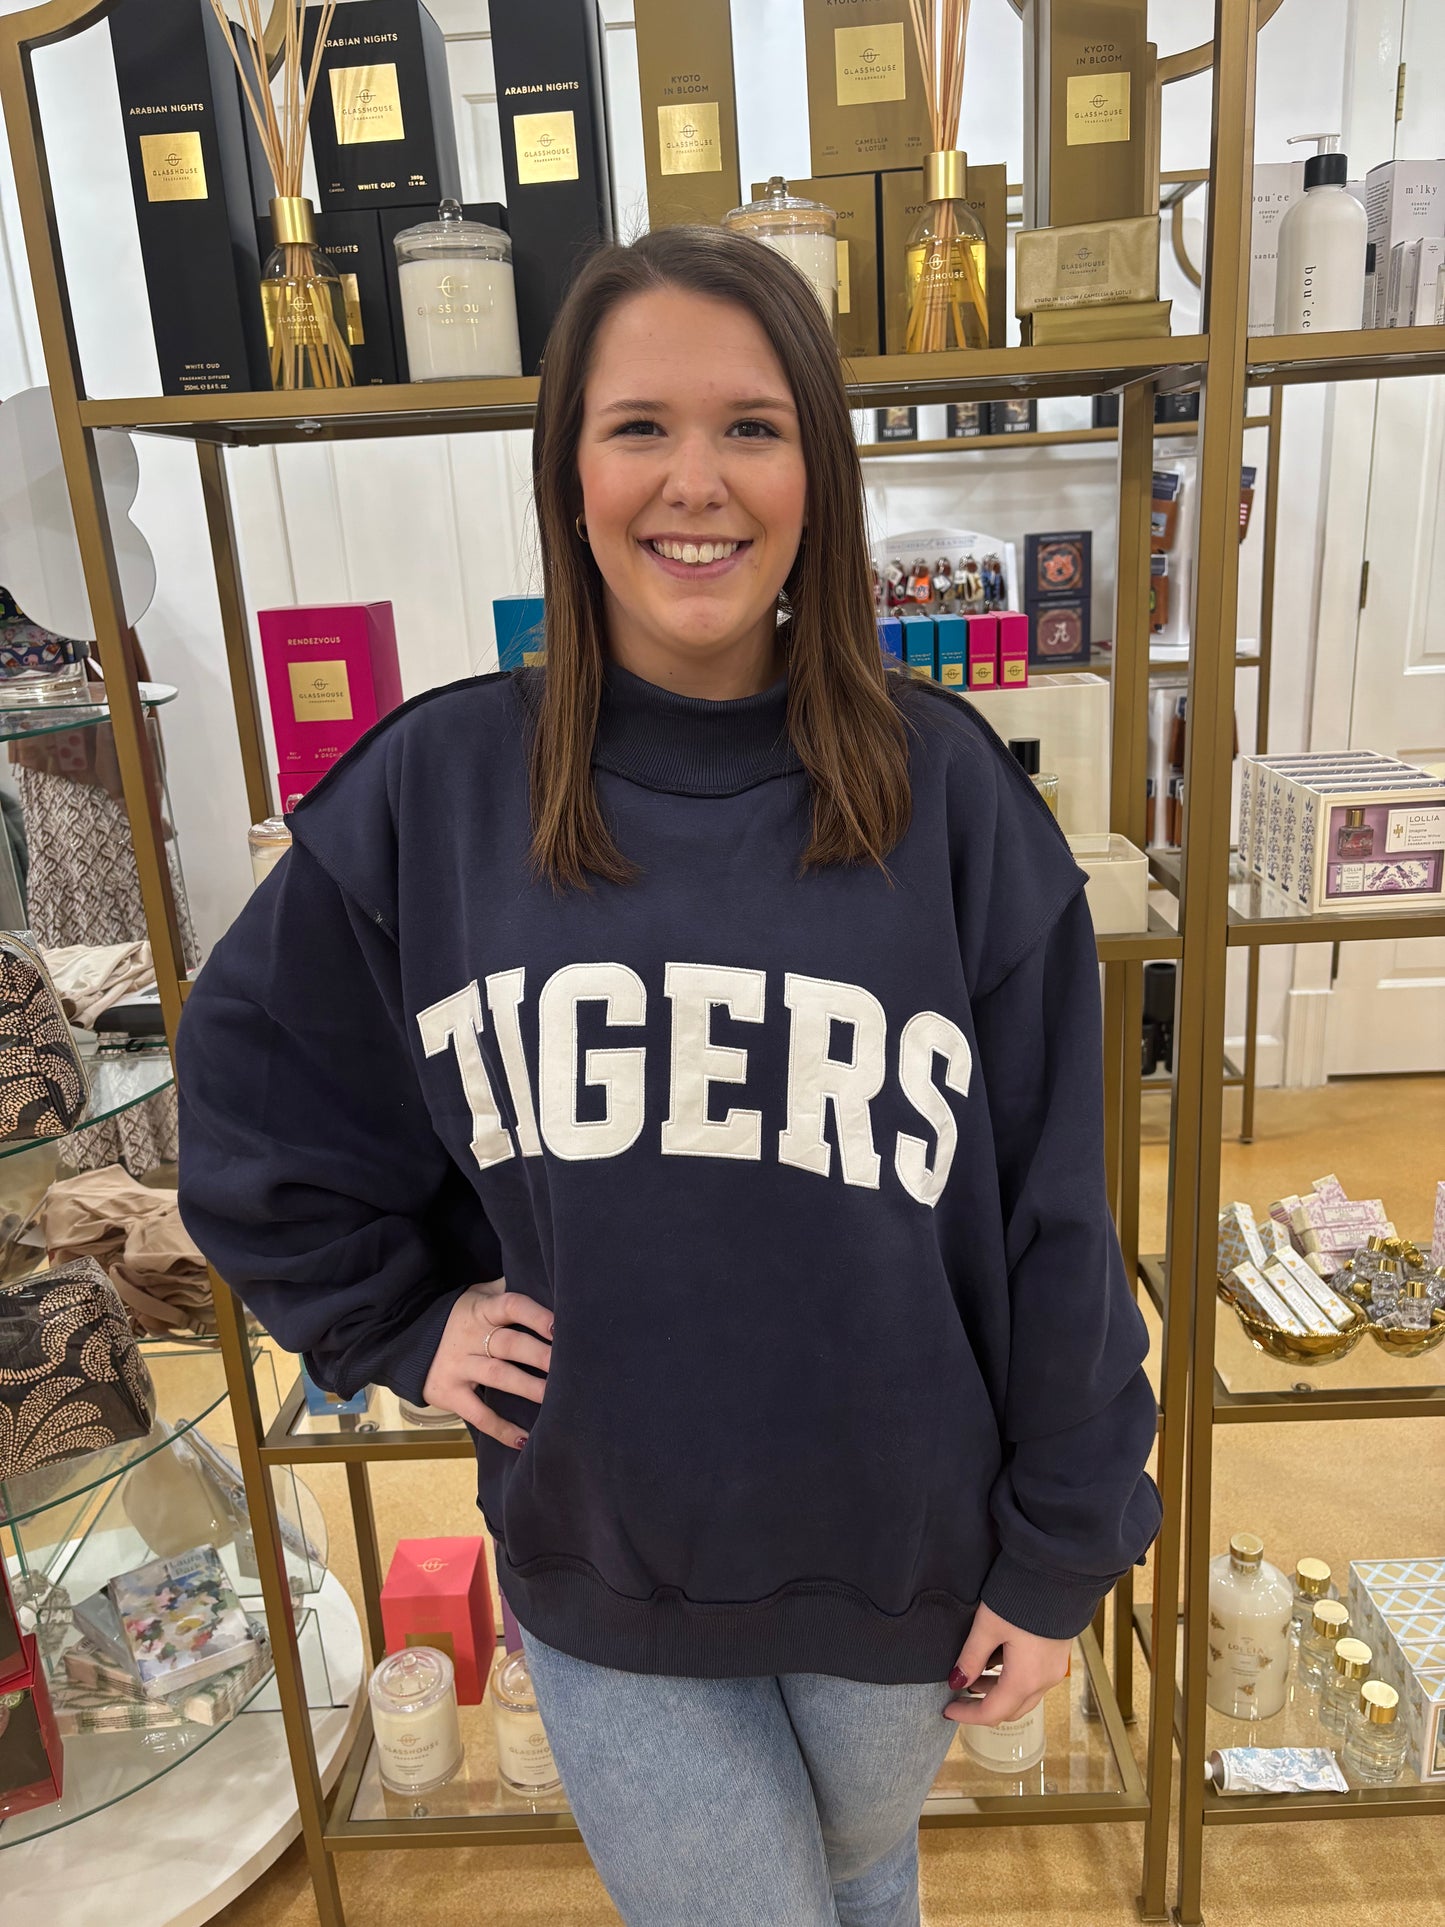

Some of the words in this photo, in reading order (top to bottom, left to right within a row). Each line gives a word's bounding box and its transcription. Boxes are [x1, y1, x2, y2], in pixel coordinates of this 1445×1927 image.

[363, 33, 398, 44] NIGHTS
[1084, 44, 1115, 54] KYOTO
[1089, 55, 1123, 64] BLOOM
[843, 64, 896, 75] GLASSHOUSE
[671, 74, 701, 84] KYOTO
[504, 84, 543, 96] ARABIAN
[545, 81, 579, 92] NIGHTS
[664, 87, 674, 95] IN
[677, 85, 709, 94] BLOOM
[129, 105, 168, 115] ARABIAN
[170, 103, 204, 112] NIGHTS
[342, 105, 394, 115] GLASSHOUSE
[1074, 108, 1123, 118] GLASSHOUSE
[666, 139, 713, 149] GLASSHOUSE
[854, 137, 888, 146] CAMELLIA
[524, 148, 570, 158] GLASSHOUSE
[152, 167, 199, 177] GLASSHOUSE
[357, 183, 379, 191] WHITE
[380, 181, 396, 189] OUD
[325, 245, 359, 255] NIGHTS
[1061, 260, 1106, 271] GLASSHOUSE
[287, 636, 341, 646] RENDEZVOUS
[1409, 815, 1440, 823] LOLLIA
[416, 961, 972, 1208] TIGERS
